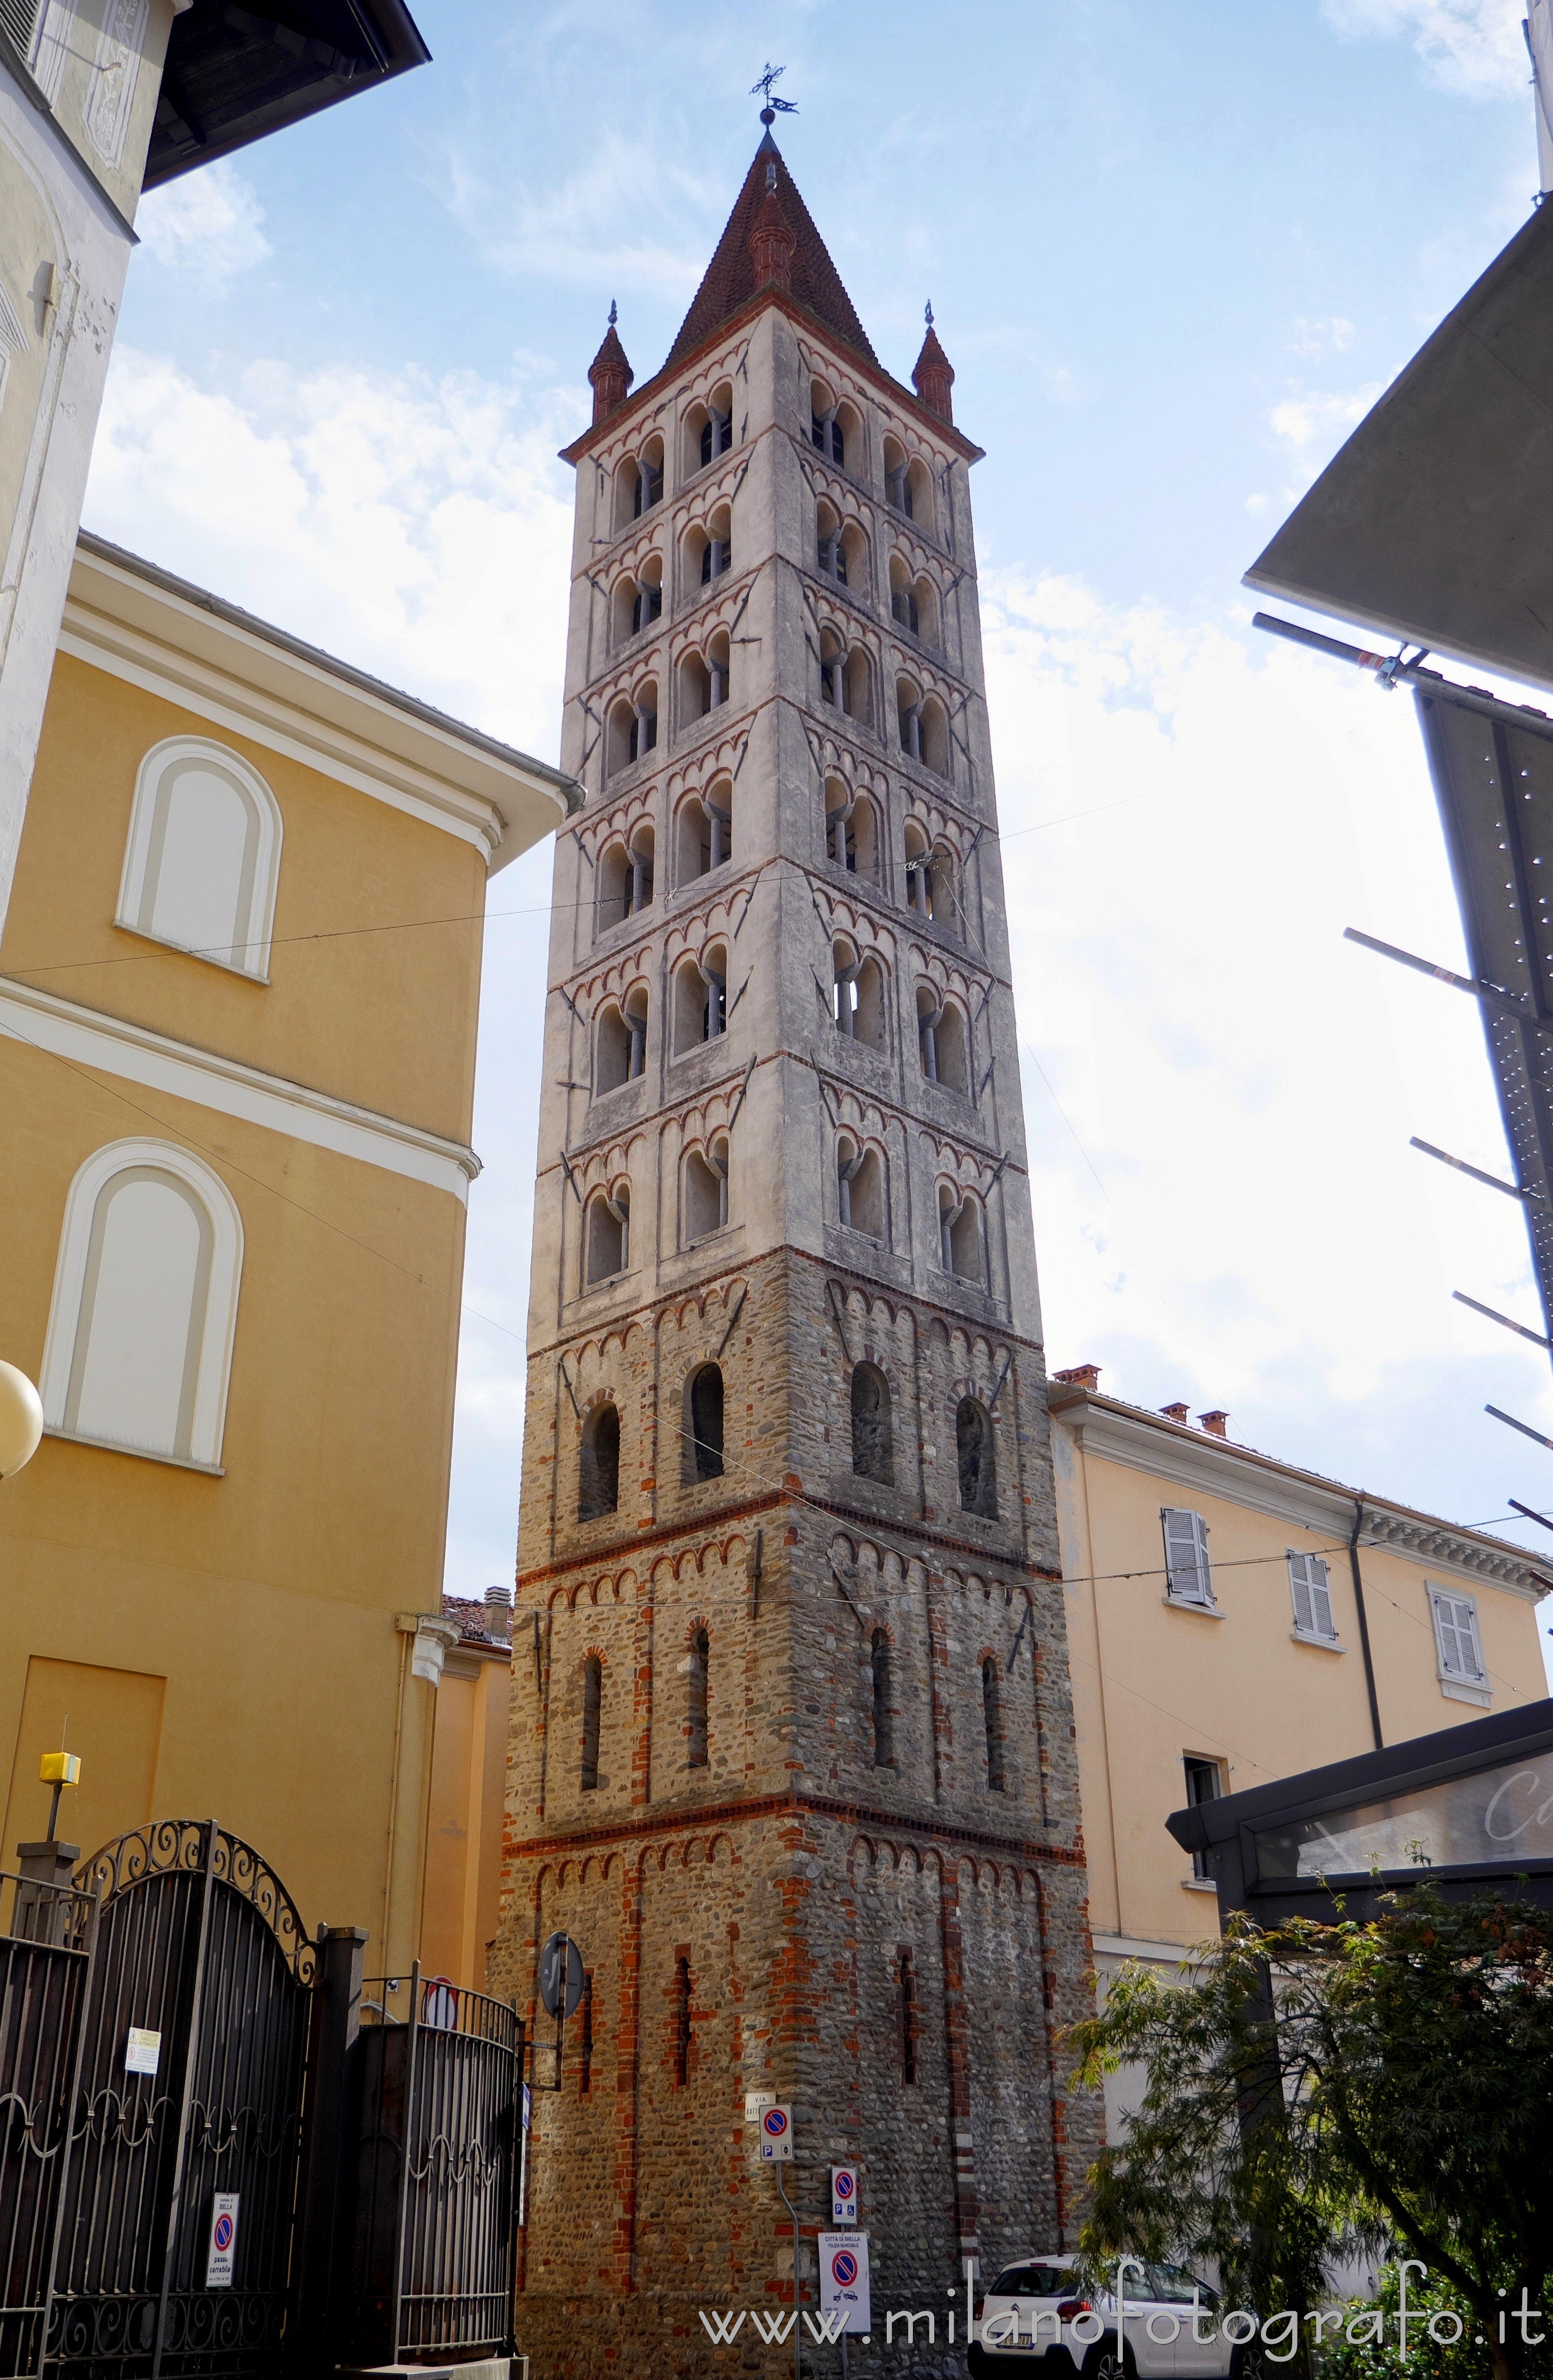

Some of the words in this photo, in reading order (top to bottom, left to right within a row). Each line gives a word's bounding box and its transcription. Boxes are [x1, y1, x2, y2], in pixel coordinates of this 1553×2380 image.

[764, 2146, 772, 2156] P
[836, 2205, 841, 2214] P
[210, 2265, 231, 2273] carrabile
